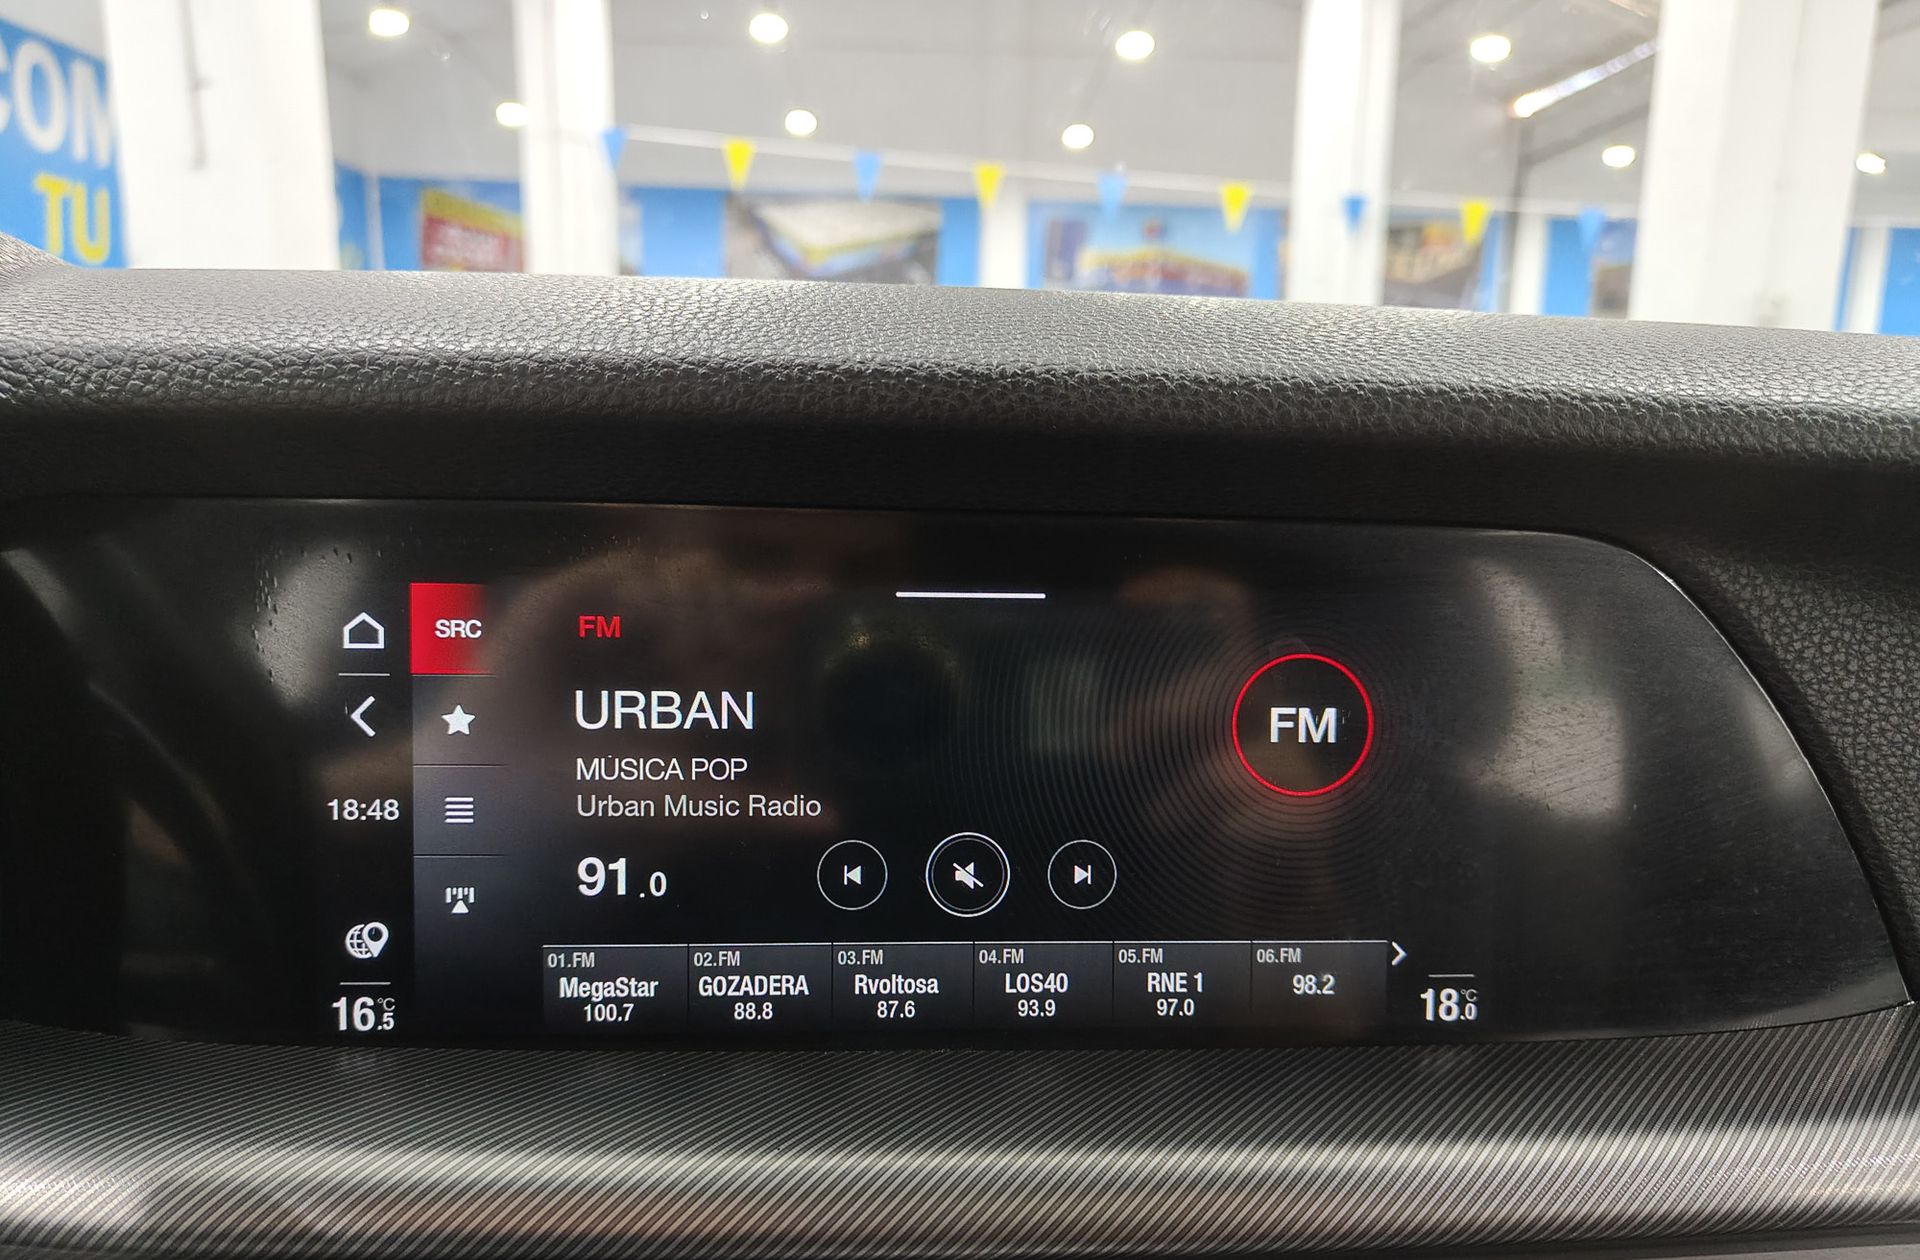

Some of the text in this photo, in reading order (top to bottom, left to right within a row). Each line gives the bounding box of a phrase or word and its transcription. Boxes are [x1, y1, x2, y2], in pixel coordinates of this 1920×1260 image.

[0, 28, 110, 168] ON
[35, 174, 110, 263] TU
[434, 618, 482, 639] SRC
[578, 615, 622, 638] FM
[574, 690, 755, 731] URBAN
[1269, 706, 1337, 743] FM
[691, 757, 748, 781] POP
[327, 799, 400, 822] 18:48
[577, 794, 822, 817] Urban Music Radio
[547, 951, 596, 969] 01.FM
[693, 950, 741, 967] 02.FM
[837, 949, 884, 966] 03.FM
[978, 948, 1024, 965] 04.FM
[1118, 948, 1163, 964] 05.FM
[1256, 947, 1302, 963] 06.FM
[559, 976, 659, 1002] MegaStar
[699, 974, 810, 996] GOZADERA
[854, 975, 939, 995] Rvoltosa
[1004, 973, 1069, 994] LOS40
[1146, 973, 1204, 993] RNE 1
[1292, 975, 1336, 995] 98.2
[583, 1003, 634, 1022] 100.7
[733, 1002, 773, 1020] 88.8
[876, 1001, 916, 1019] 87.6
[1017, 1000, 1056, 1018] 93.9
[1156, 999, 1195, 1017] 97.0
